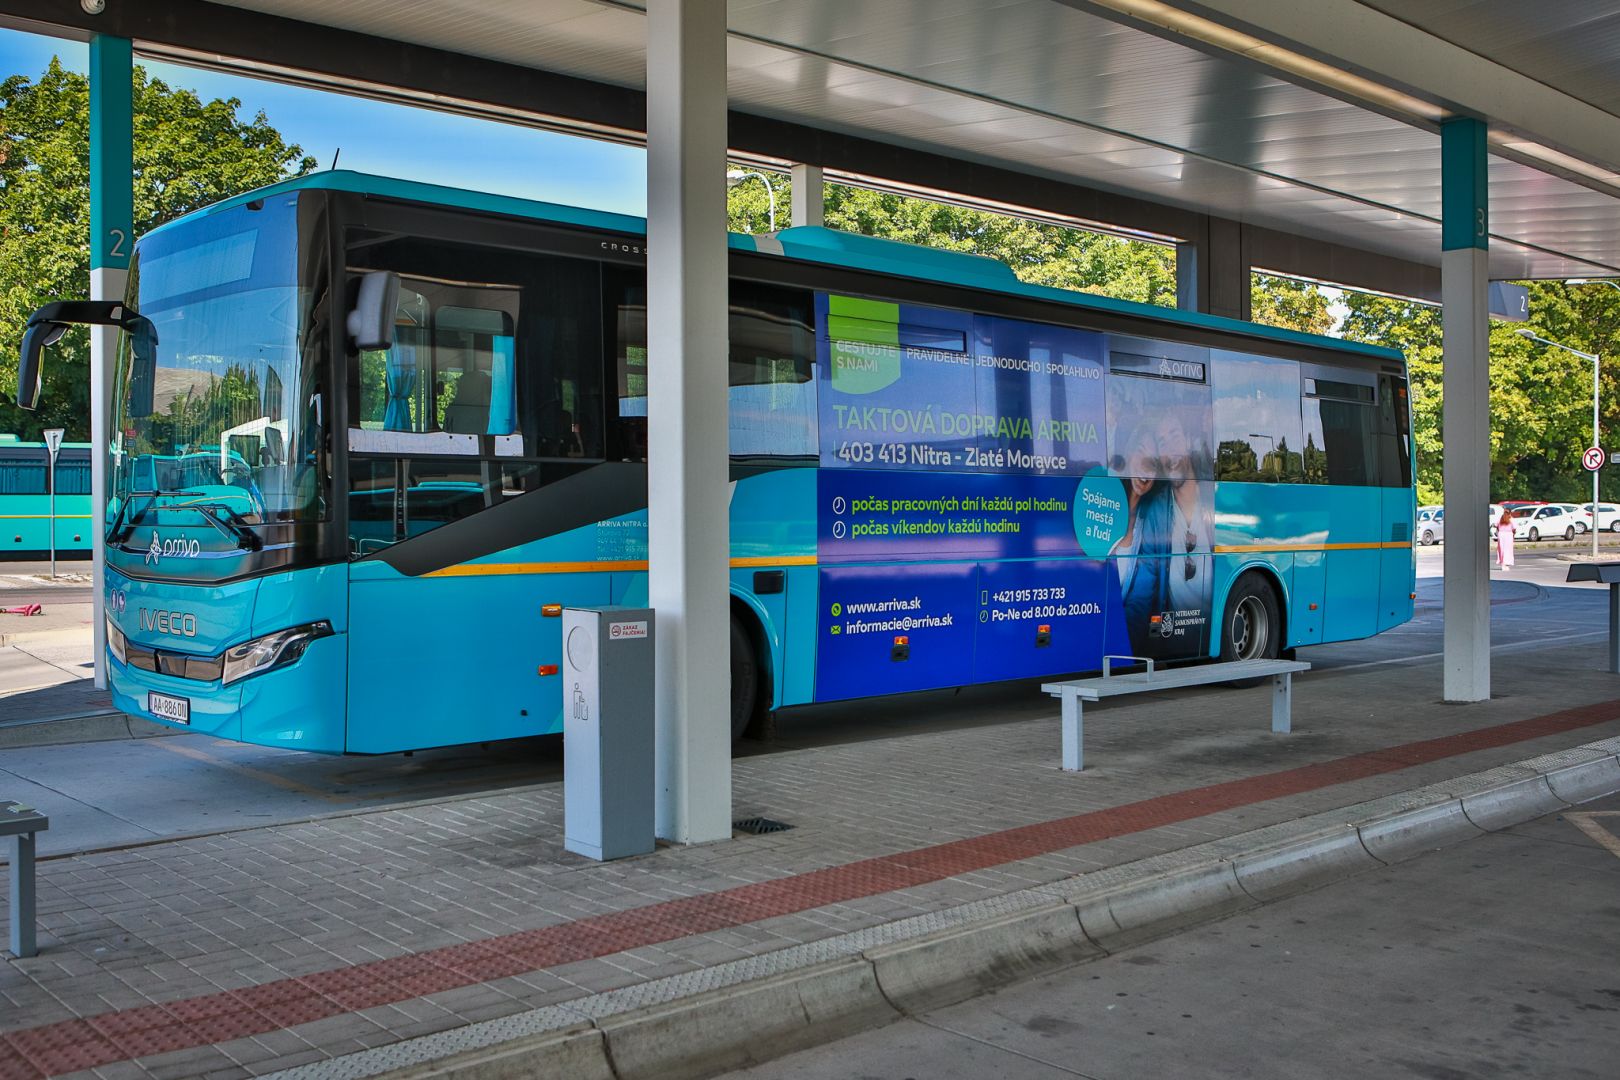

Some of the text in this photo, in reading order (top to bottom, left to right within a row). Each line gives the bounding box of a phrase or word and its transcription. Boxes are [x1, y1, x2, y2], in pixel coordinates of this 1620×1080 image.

[1477, 208, 1485, 237] 3
[110, 229, 125, 257] 2
[1520, 296, 1526, 312] 2
[836, 339, 896, 358] CESTUJTE
[836, 356, 878, 373] S NAMI
[906, 348, 970, 366] PRAVIDELNE
[975, 356, 1041, 373] JEDNODUCHO
[833, 404, 1099, 444] TAKTOVÁ DOPRAVA ARRIVA
[839, 441, 874, 464] 403
[878, 442, 907, 464] 413
[911, 445, 952, 466] Nitra
[965, 446, 1004, 468] Zlaté
[1007, 449, 1067, 470] Moravce
[852, 496, 1067, 515] počas pracovných dní každú pol hodinu
[1082, 488, 1121, 511] Spájame
[597, 520, 621, 528] ARRIVA
[622, 520, 641, 528] NITRA
[1086, 508, 1114, 526] mestá
[852, 518, 1020, 539] počas víkendov každú hodinu
[1086, 525, 1111, 541] a ľudí
[164, 533, 200, 558] arriva
[992, 587, 1066, 603] +421 915 733 733
[846, 597, 921, 614] www.arriva.sk
[992, 602, 1101, 621] Po-Ne od 8.00 do 20.00 h.
[139, 608, 197, 637] IVECO
[846, 613, 953, 634] informacie@arriva.sk
